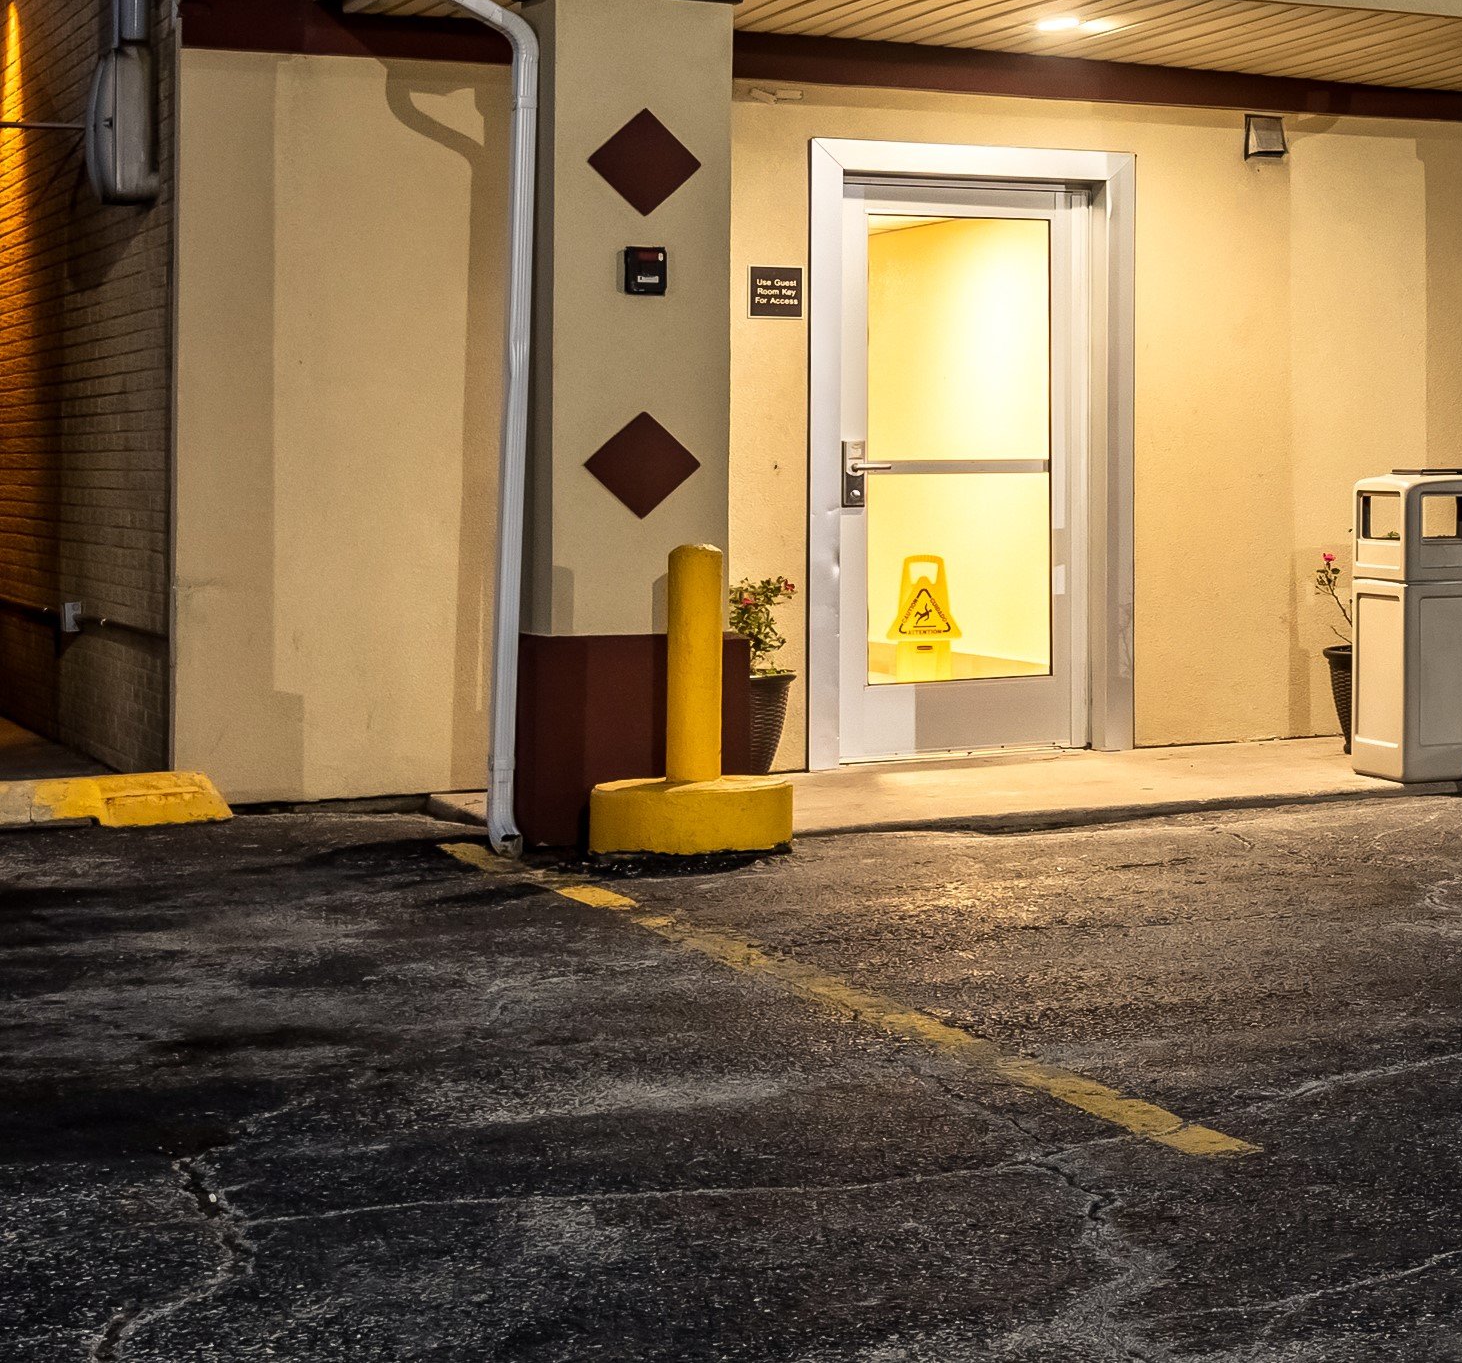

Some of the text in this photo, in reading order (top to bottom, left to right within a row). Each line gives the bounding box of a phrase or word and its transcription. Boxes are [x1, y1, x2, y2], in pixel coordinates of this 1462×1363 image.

[756, 278, 797, 287] Use Guest
[757, 287, 796, 297] Room Key
[755, 296, 799, 305] For Access
[902, 598, 918, 623] CAUTION
[930, 598, 947, 623] CUIDADO
